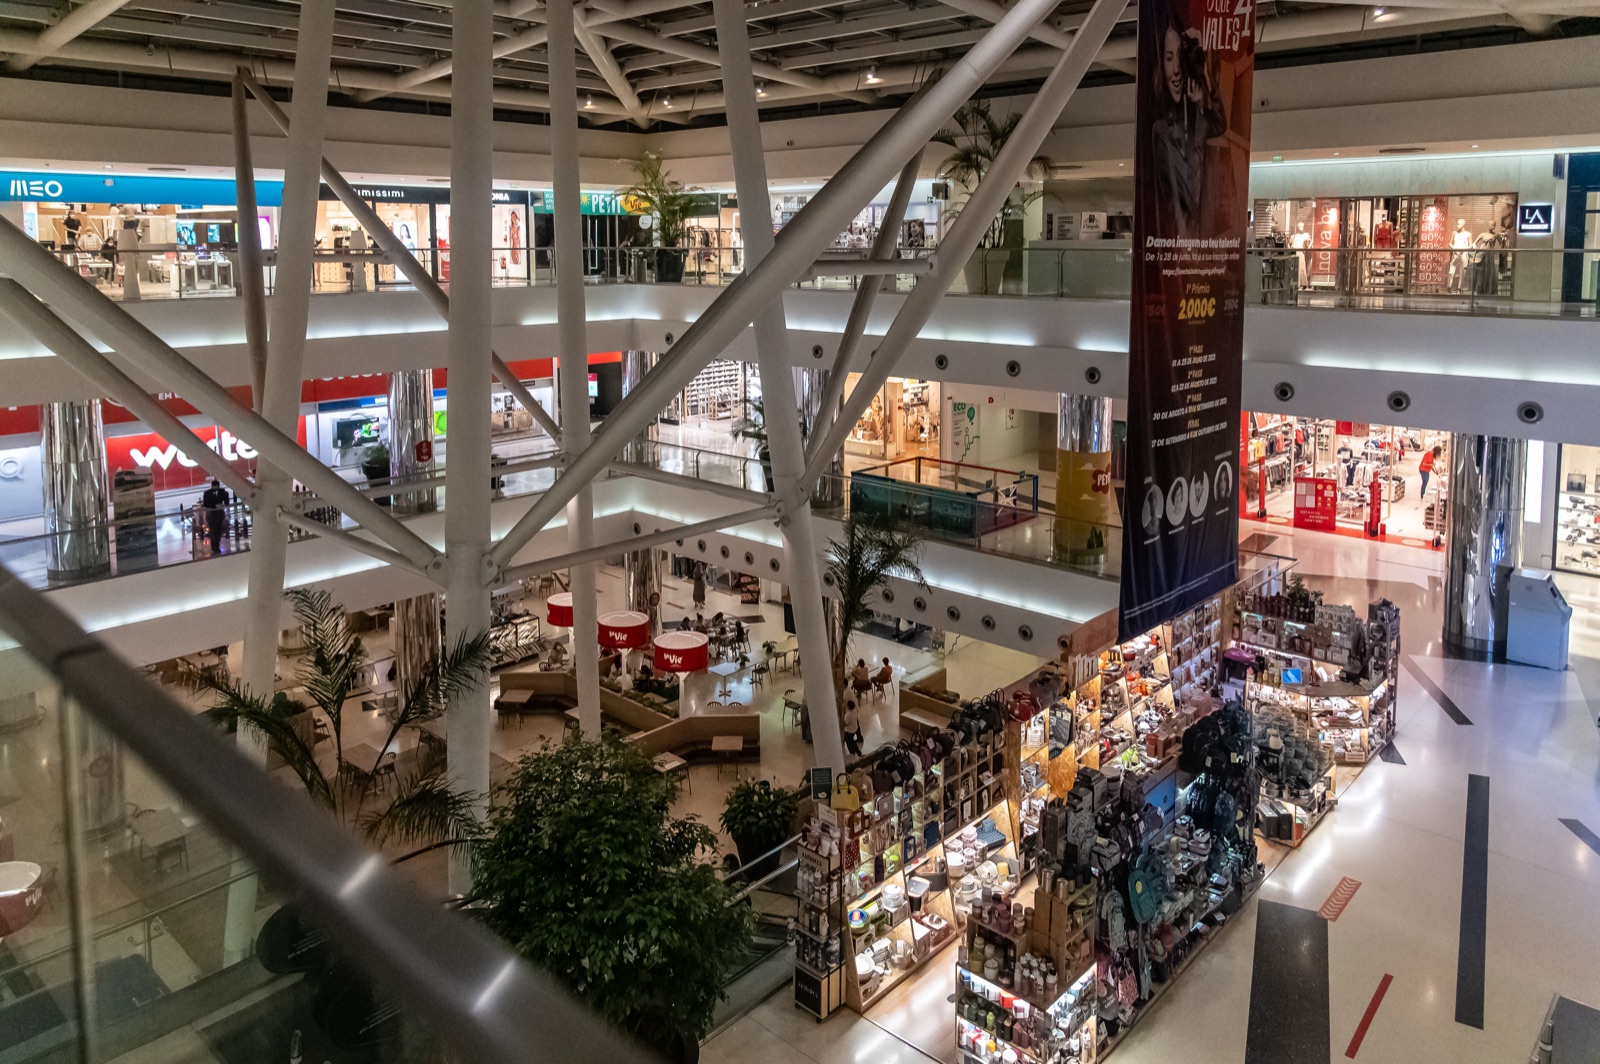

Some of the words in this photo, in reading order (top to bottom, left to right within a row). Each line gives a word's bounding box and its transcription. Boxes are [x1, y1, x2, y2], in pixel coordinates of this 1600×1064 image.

[1202, 16, 1240, 52] VALES
[10, 180, 63, 198] MEO
[353, 188, 404, 198] imissimi
[592, 194, 622, 214] PETIT
[1526, 208, 1544, 223] LA
[1422, 223, 1444, 231] 60%
[1421, 233, 1444, 242] 60%
[1146, 236, 1175, 248] Damos
[1176, 236, 1200, 251] imagem
[1201, 239, 1208, 248] ao
[1219, 238, 1240, 248] talento!
[1146, 253, 1155, 261] De
[1163, 252, 1171, 261] 28
[1420, 253, 1442, 261] 60%
[1420, 263, 1442, 271] 60%
[1419, 272, 1441, 281] 60%
[1192, 282, 1210, 294] Prémio
[1178, 297, 1216, 320] 2.000€
[158, 392, 172, 401] EM
[954, 402, 966, 411] ECO
[1153, 412, 1161, 420] 30
[1161, 411, 1168, 420] DE
[614, 631, 628, 641] Vie
[669, 655, 683, 664] Vie
